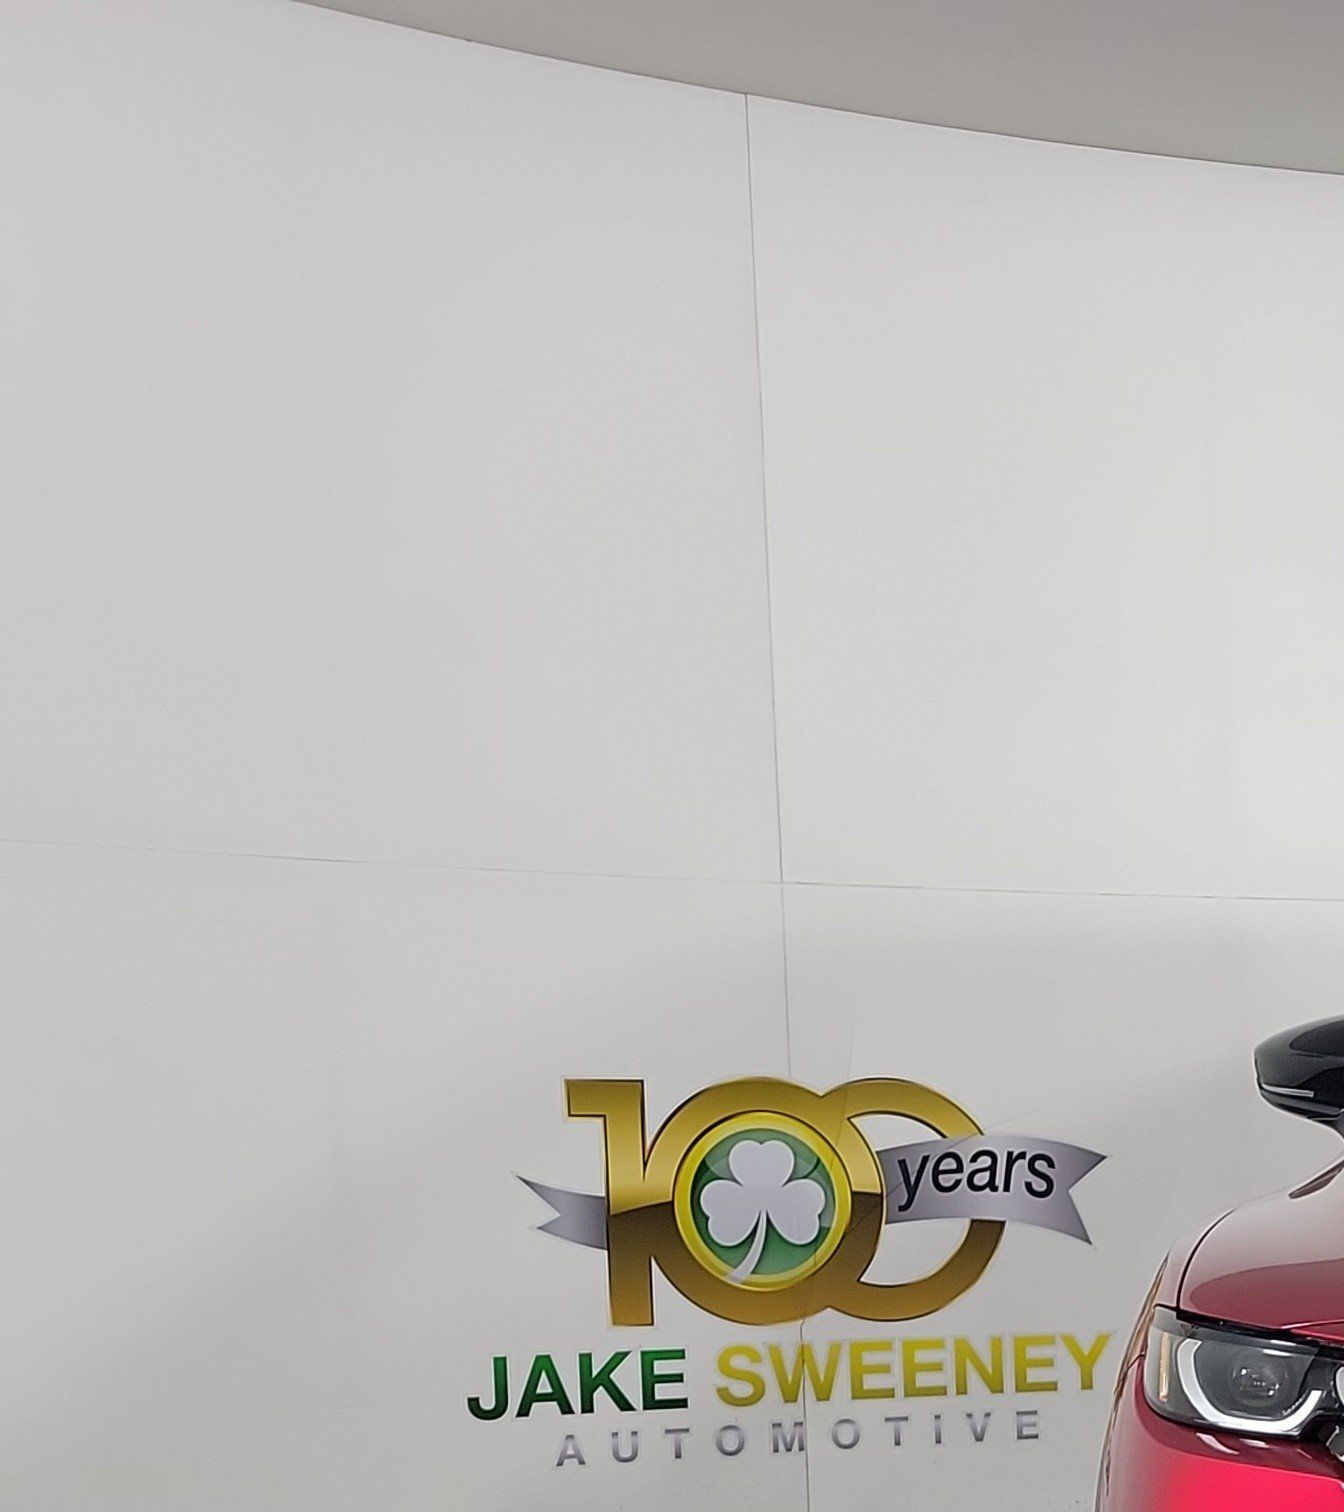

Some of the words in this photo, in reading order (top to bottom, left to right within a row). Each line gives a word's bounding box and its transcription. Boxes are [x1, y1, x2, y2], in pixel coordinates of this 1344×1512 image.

[896, 1147, 1057, 1212] years
[466, 1347, 690, 1422] JAKE
[714, 1331, 1114, 1409] SWEENEY
[555, 1410, 1042, 1468] AUTOMOTIVE
